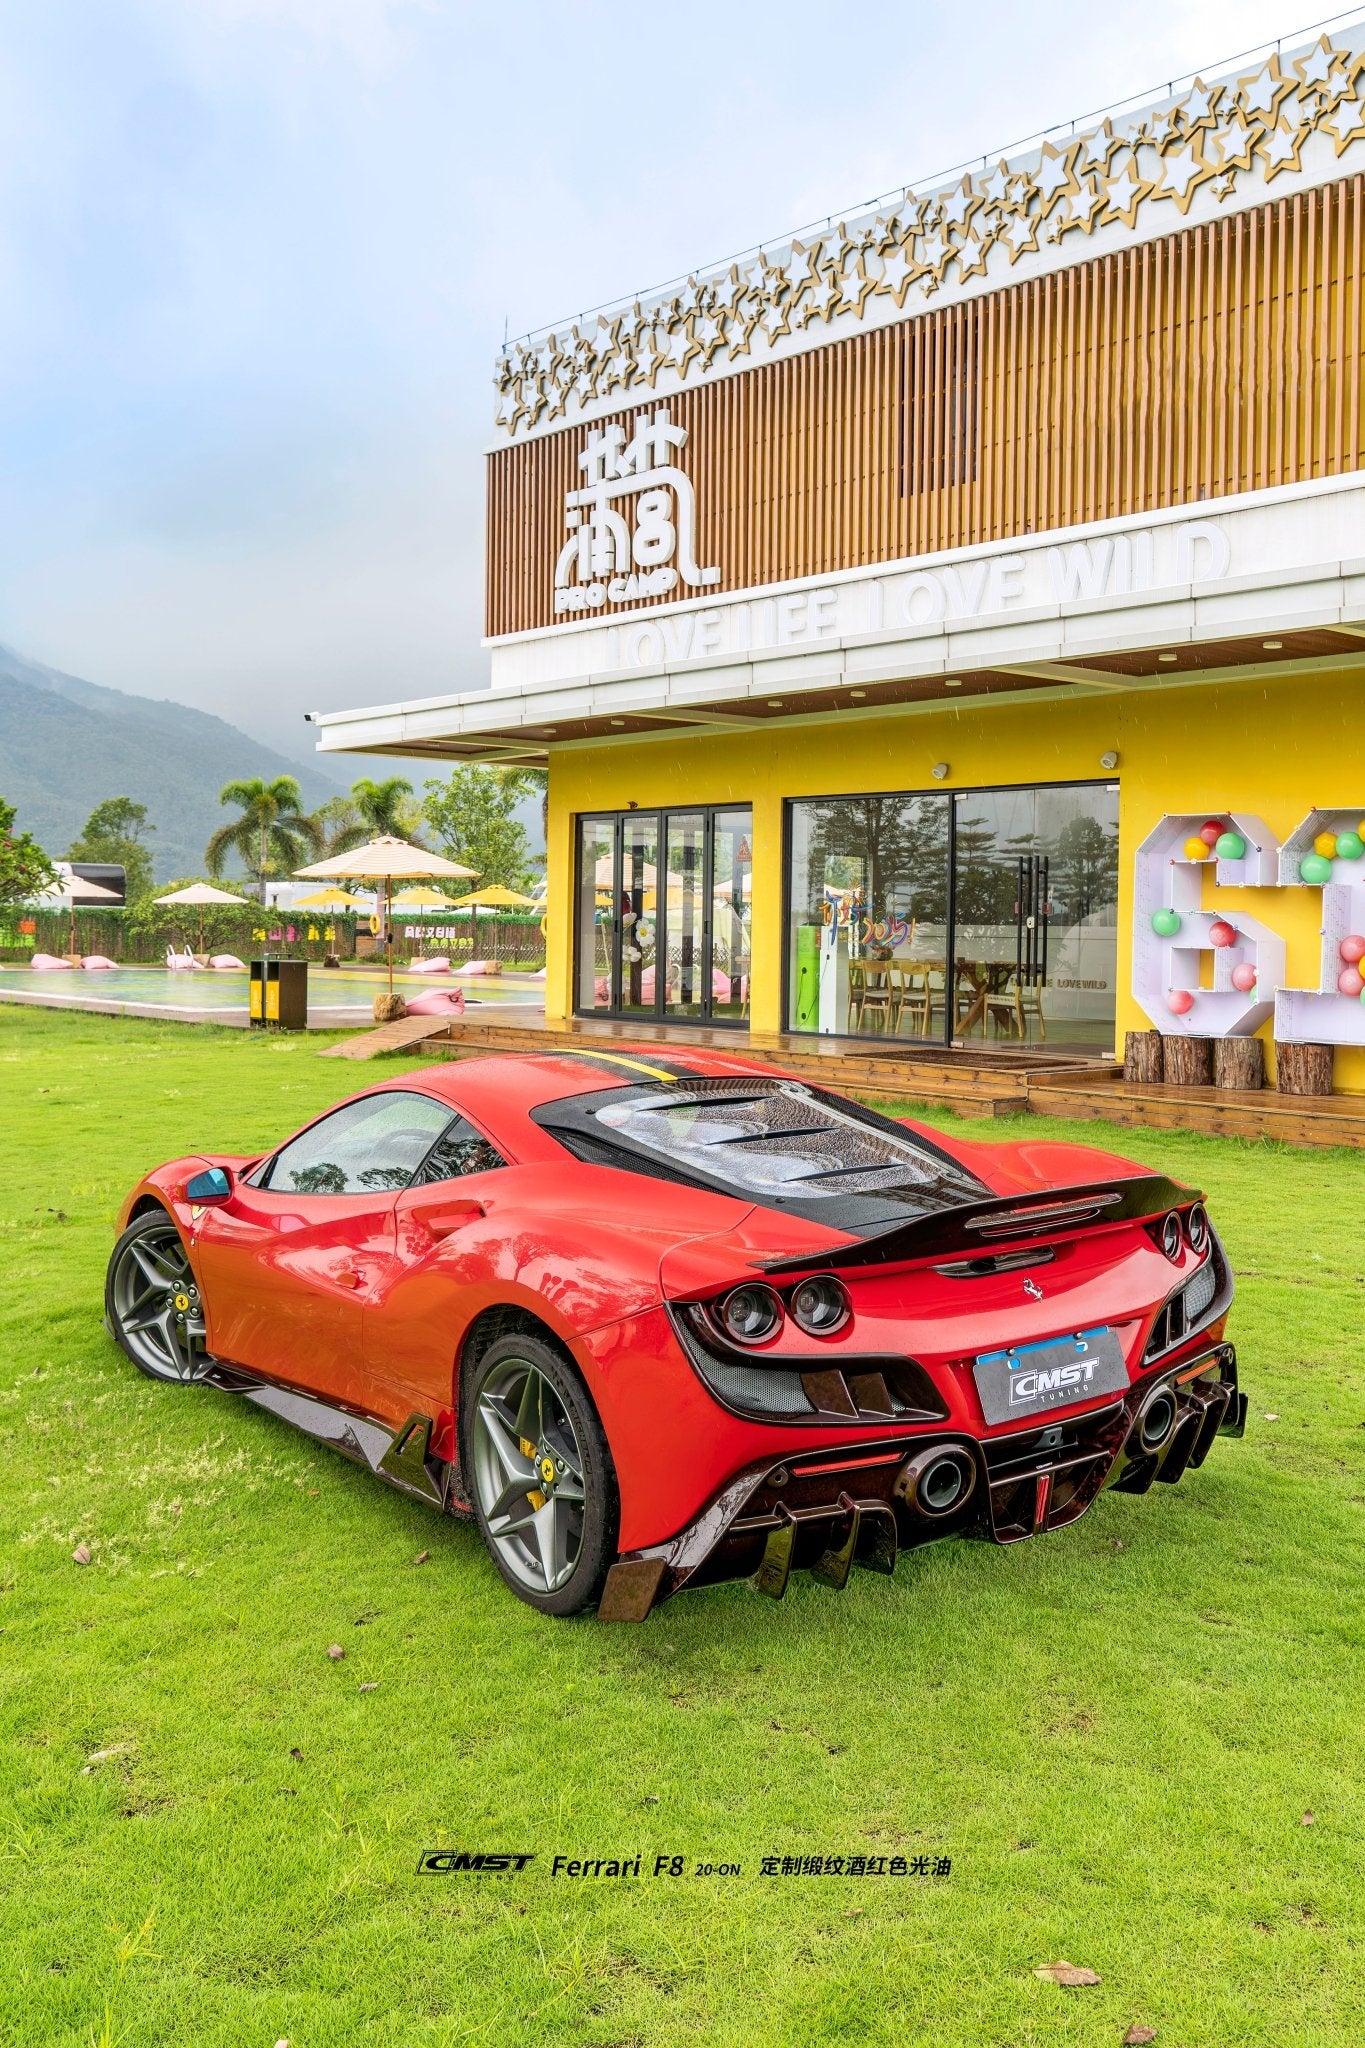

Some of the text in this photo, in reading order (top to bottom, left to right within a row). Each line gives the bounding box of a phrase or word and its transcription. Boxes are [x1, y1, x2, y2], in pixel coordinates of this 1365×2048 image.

[554, 567, 679, 614] PRO CAMP
[1011, 1357, 1099, 1403] CMST
[1040, 1384, 1090, 1403] TUNING
